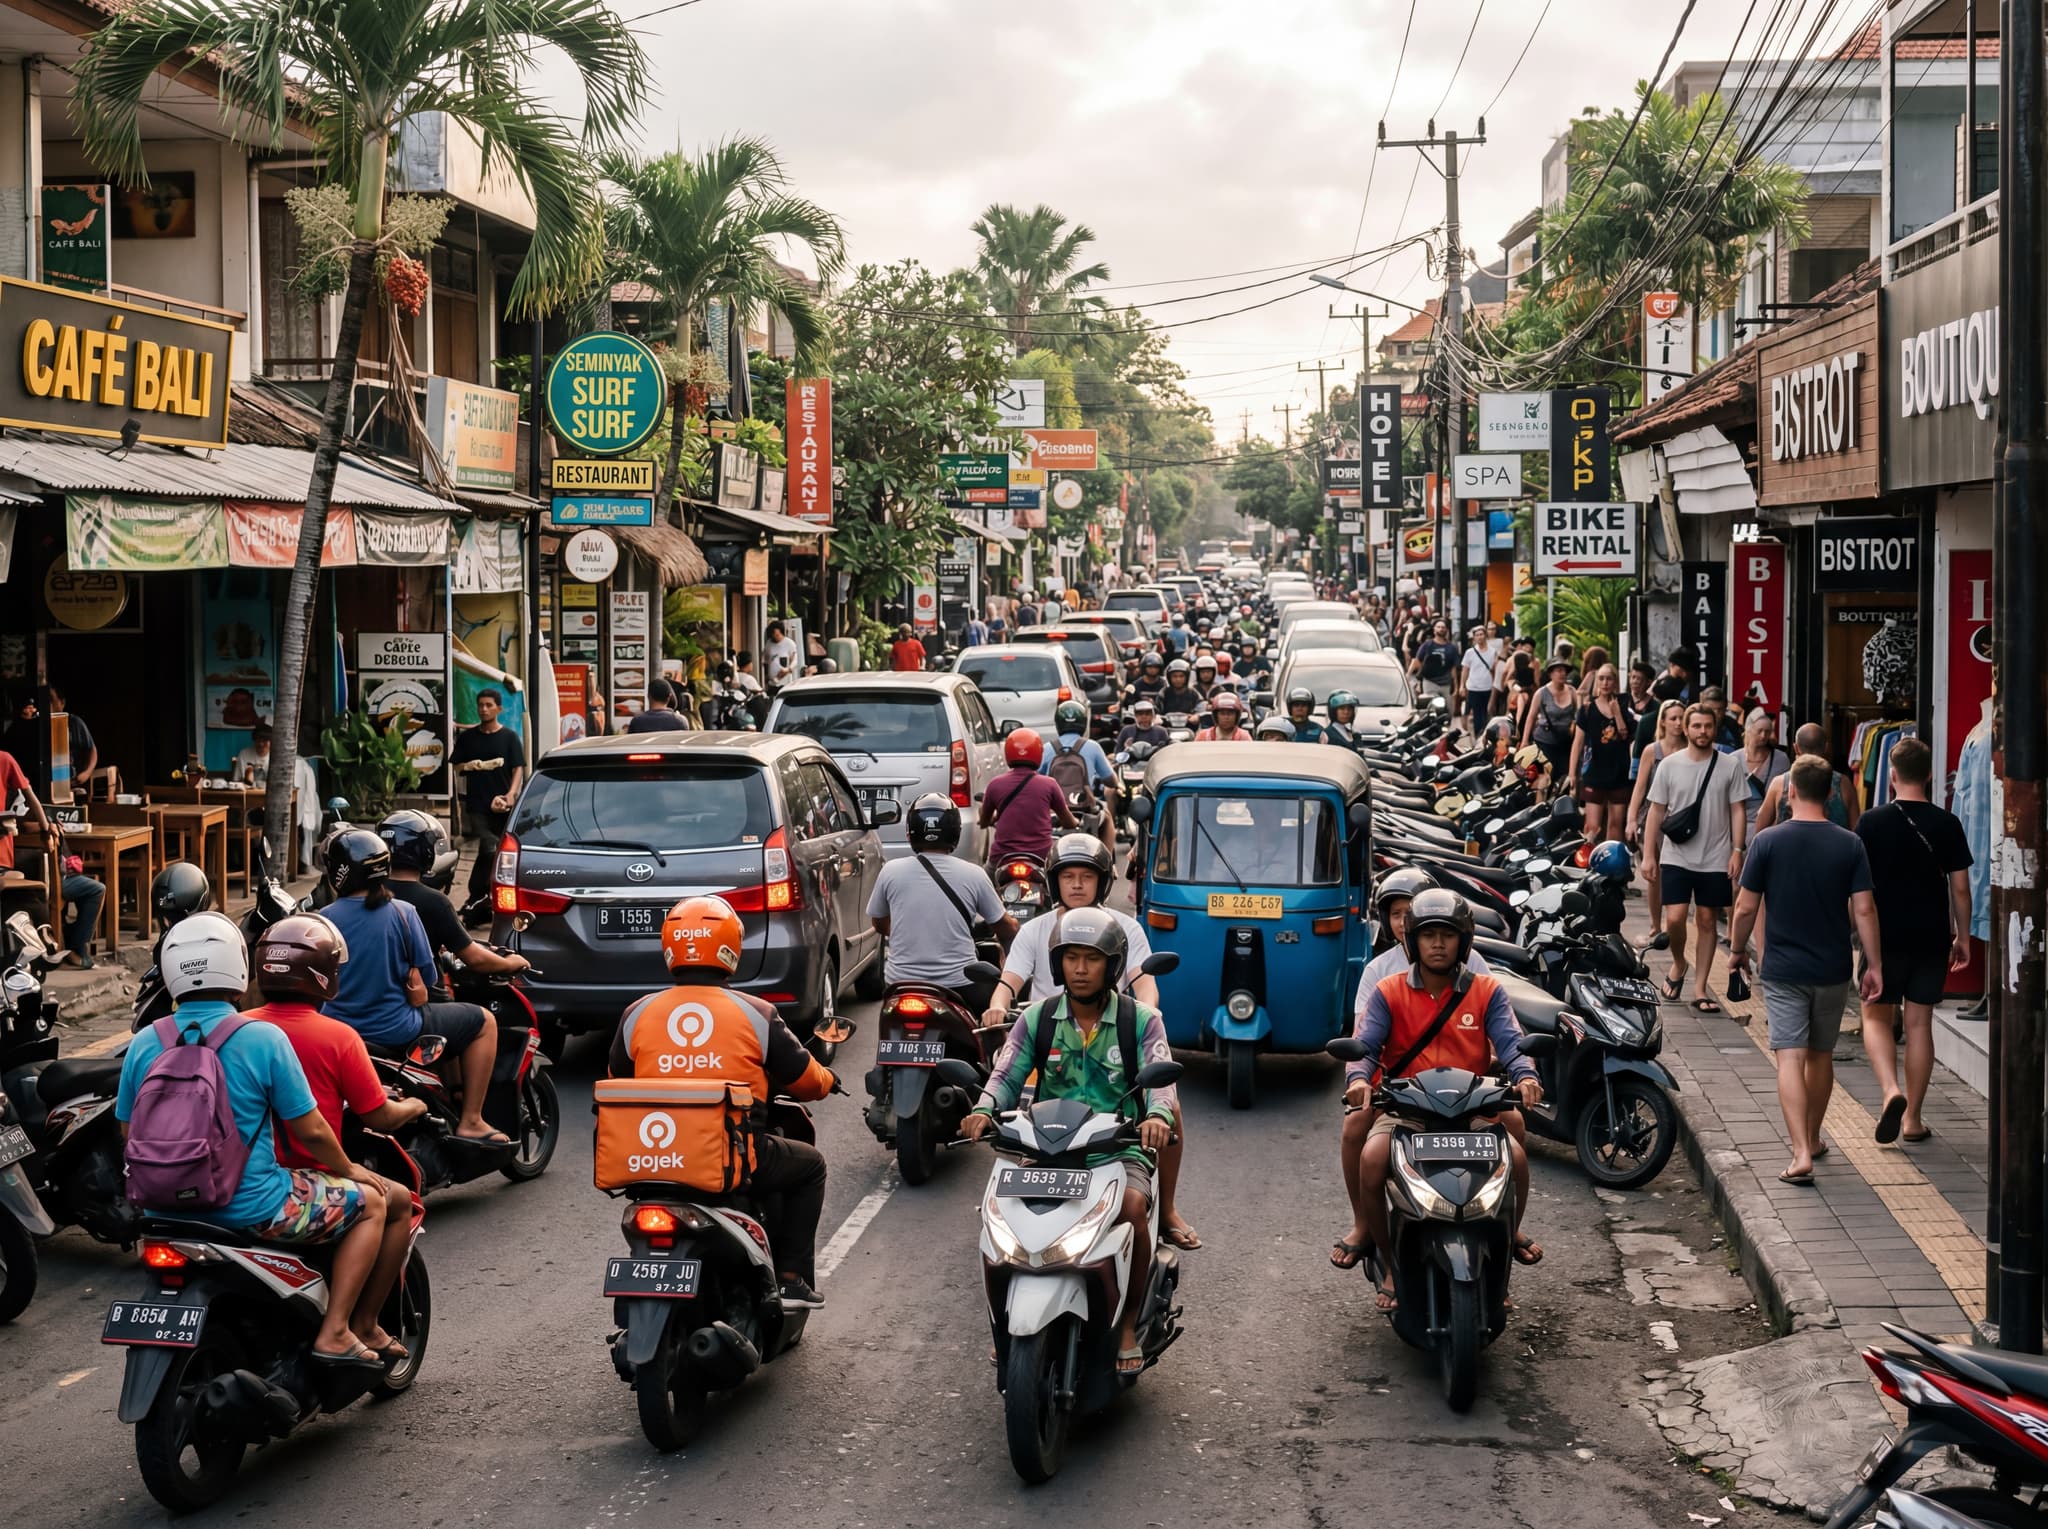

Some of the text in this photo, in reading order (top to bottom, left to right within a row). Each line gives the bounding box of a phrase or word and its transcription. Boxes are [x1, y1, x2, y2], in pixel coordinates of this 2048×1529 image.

[49, 240, 101, 248] CAFE BALI
[23, 314, 213, 418] CAFÉ BALI
[566, 352, 642, 374] SEMINYAK
[1901, 304, 1999, 420] BOUTIQU
[572, 377, 635, 406] SURF
[1771, 351, 1863, 461] BISTROT
[572, 409, 635, 439] SURF
[801, 386, 817, 510] RESTAURANT
[1369, 392, 1392, 503] HOTEL
[556, 466, 648, 485] RESTAURANT
[1464, 466, 1511, 485] SPA
[1547, 508, 1625, 530] BIKE
[1542, 536, 1631, 555] RENTAL
[1820, 537, 1915, 571] BISTROT
[600, 909, 608, 925] B
[620, 909, 651, 924] 1555
[673, 927, 712, 941] gojek
[658, 1052, 723, 1073] gojek
[628, 1151, 684, 1173] gojek
[1003, 1171, 1013, 1183] R
[112, 1306, 123, 1322] B
[179, 1310, 199, 1327] AH
